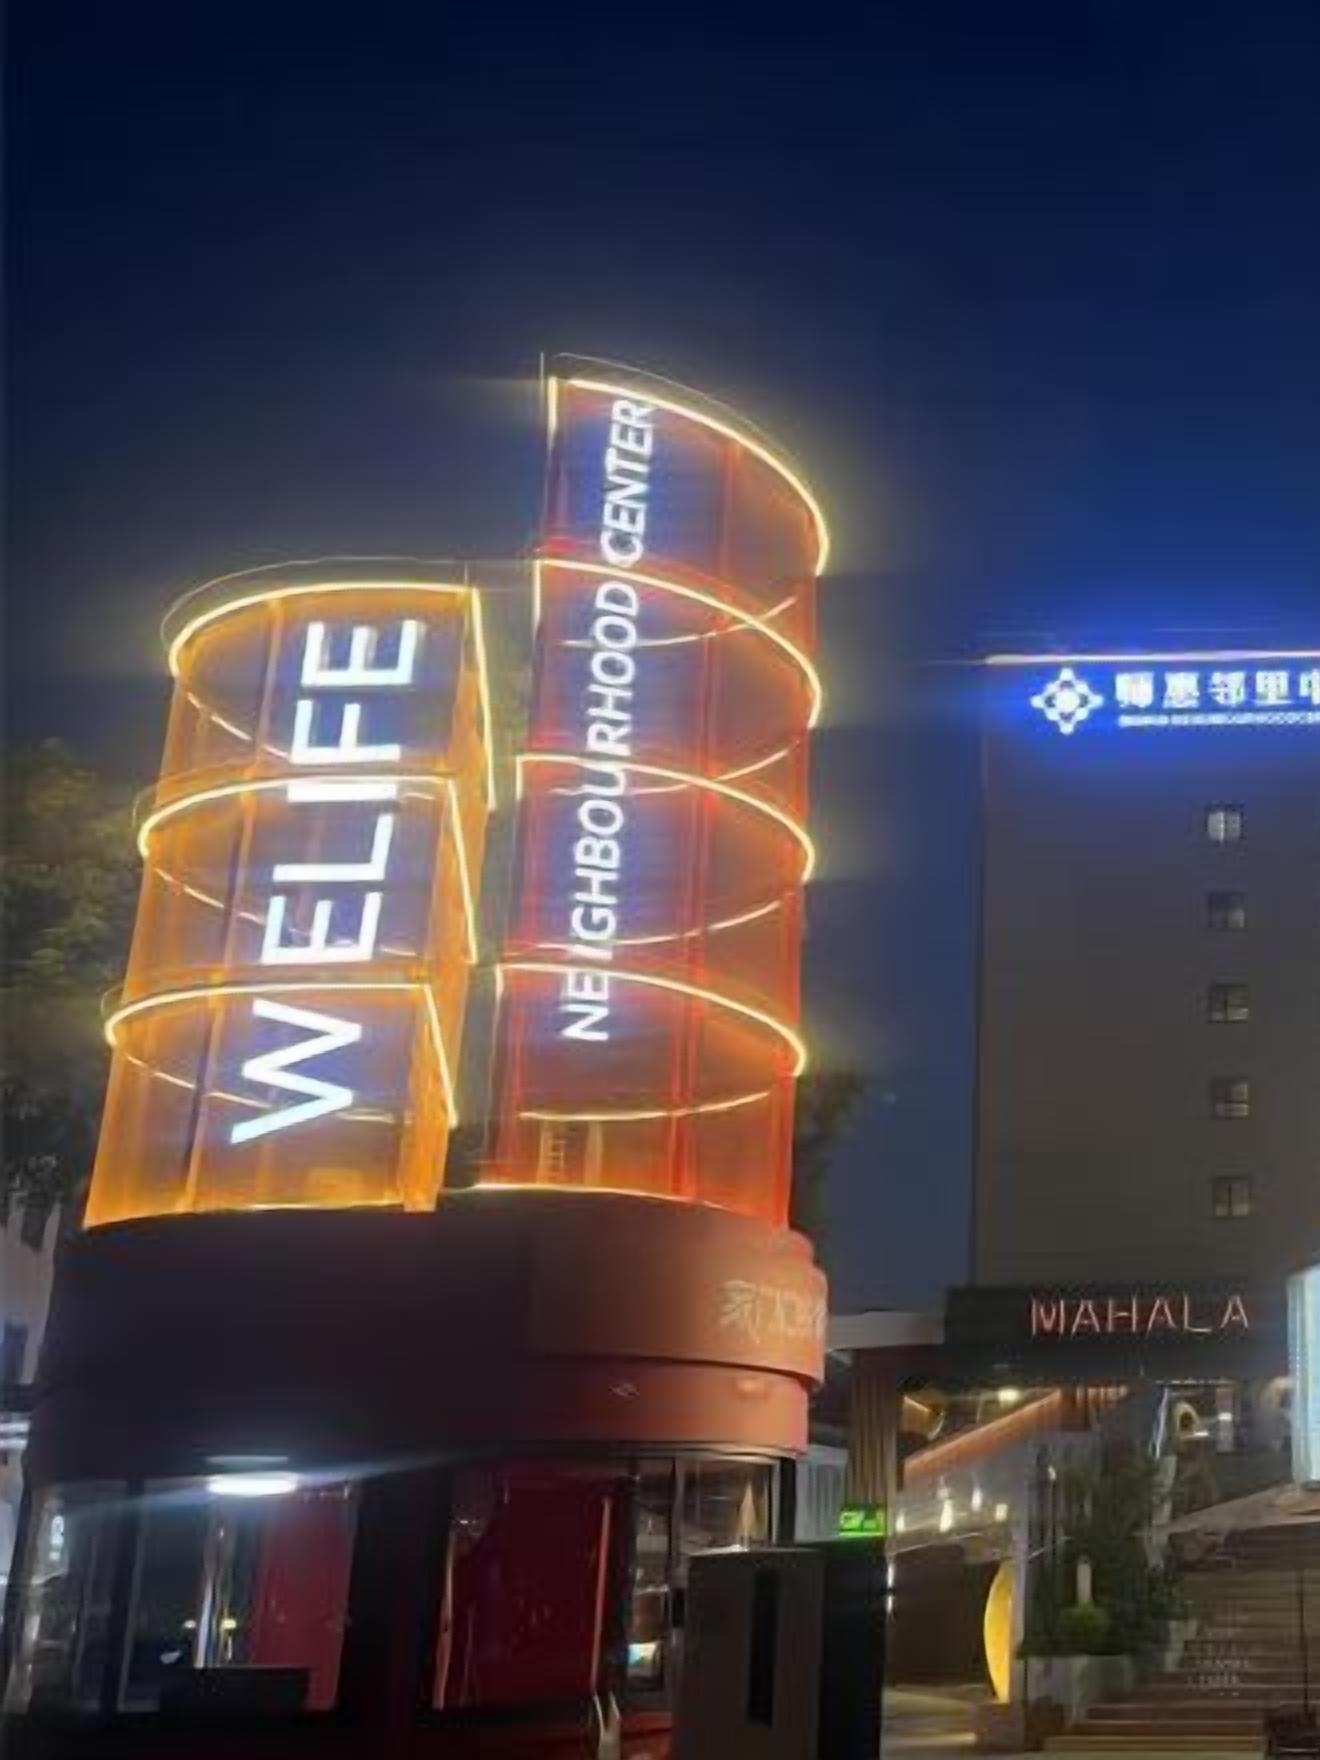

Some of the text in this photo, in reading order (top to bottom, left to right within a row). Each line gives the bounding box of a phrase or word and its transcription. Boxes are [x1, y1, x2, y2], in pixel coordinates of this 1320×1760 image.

[230, 618, 427, 1145] WELIFE
[560, 400, 655, 1042] NEIGHBOURHOOD CENTER
[1030, 1296, 1249, 1337] MAHALA
